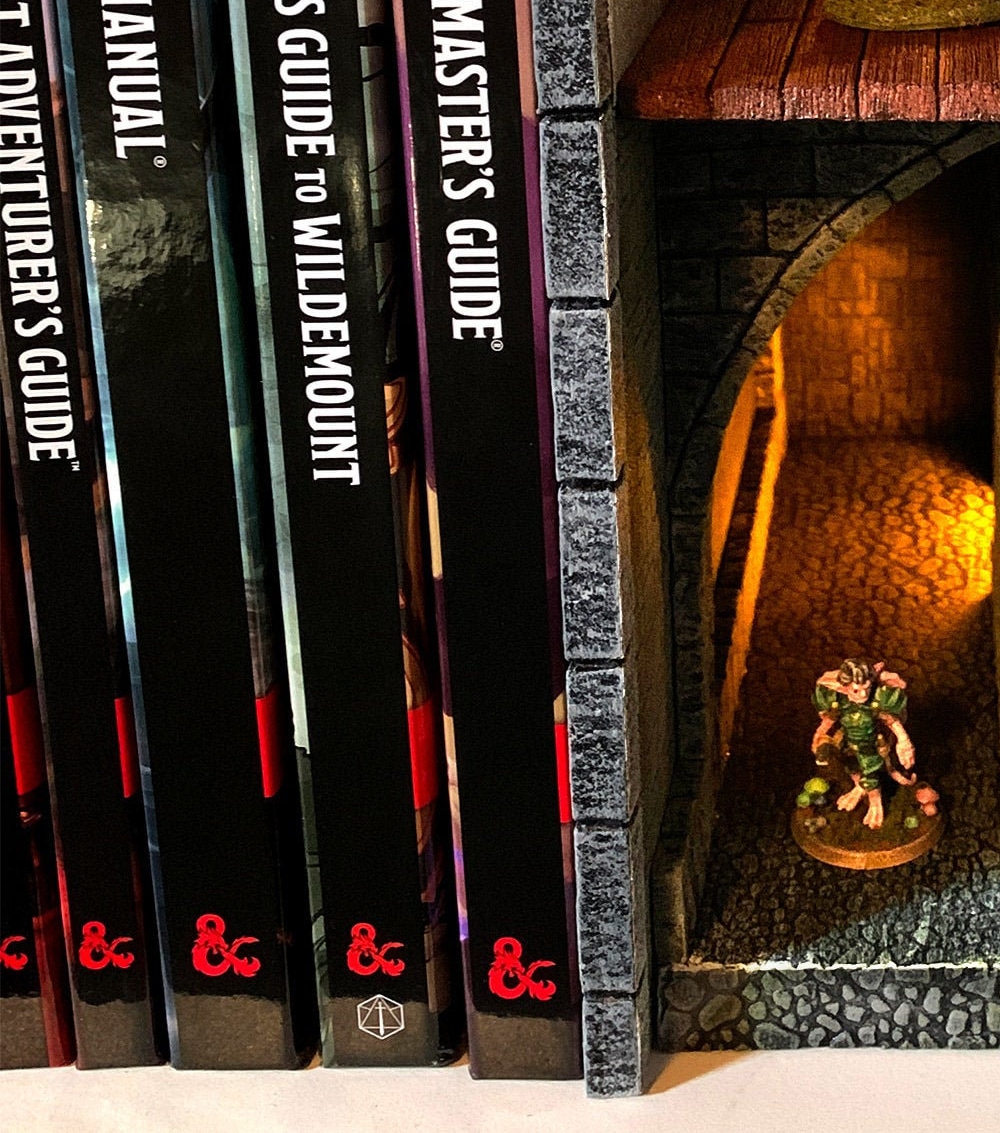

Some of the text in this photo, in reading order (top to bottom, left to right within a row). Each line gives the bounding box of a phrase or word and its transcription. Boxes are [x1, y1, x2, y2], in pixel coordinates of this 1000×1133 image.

[0, 43, 63, 338] ADVENTURER'S
[276, 28, 336, 157] GUIDE
[294, 168, 324, 203] TO
[294, 212, 362, 486] WILDEMOUNT
